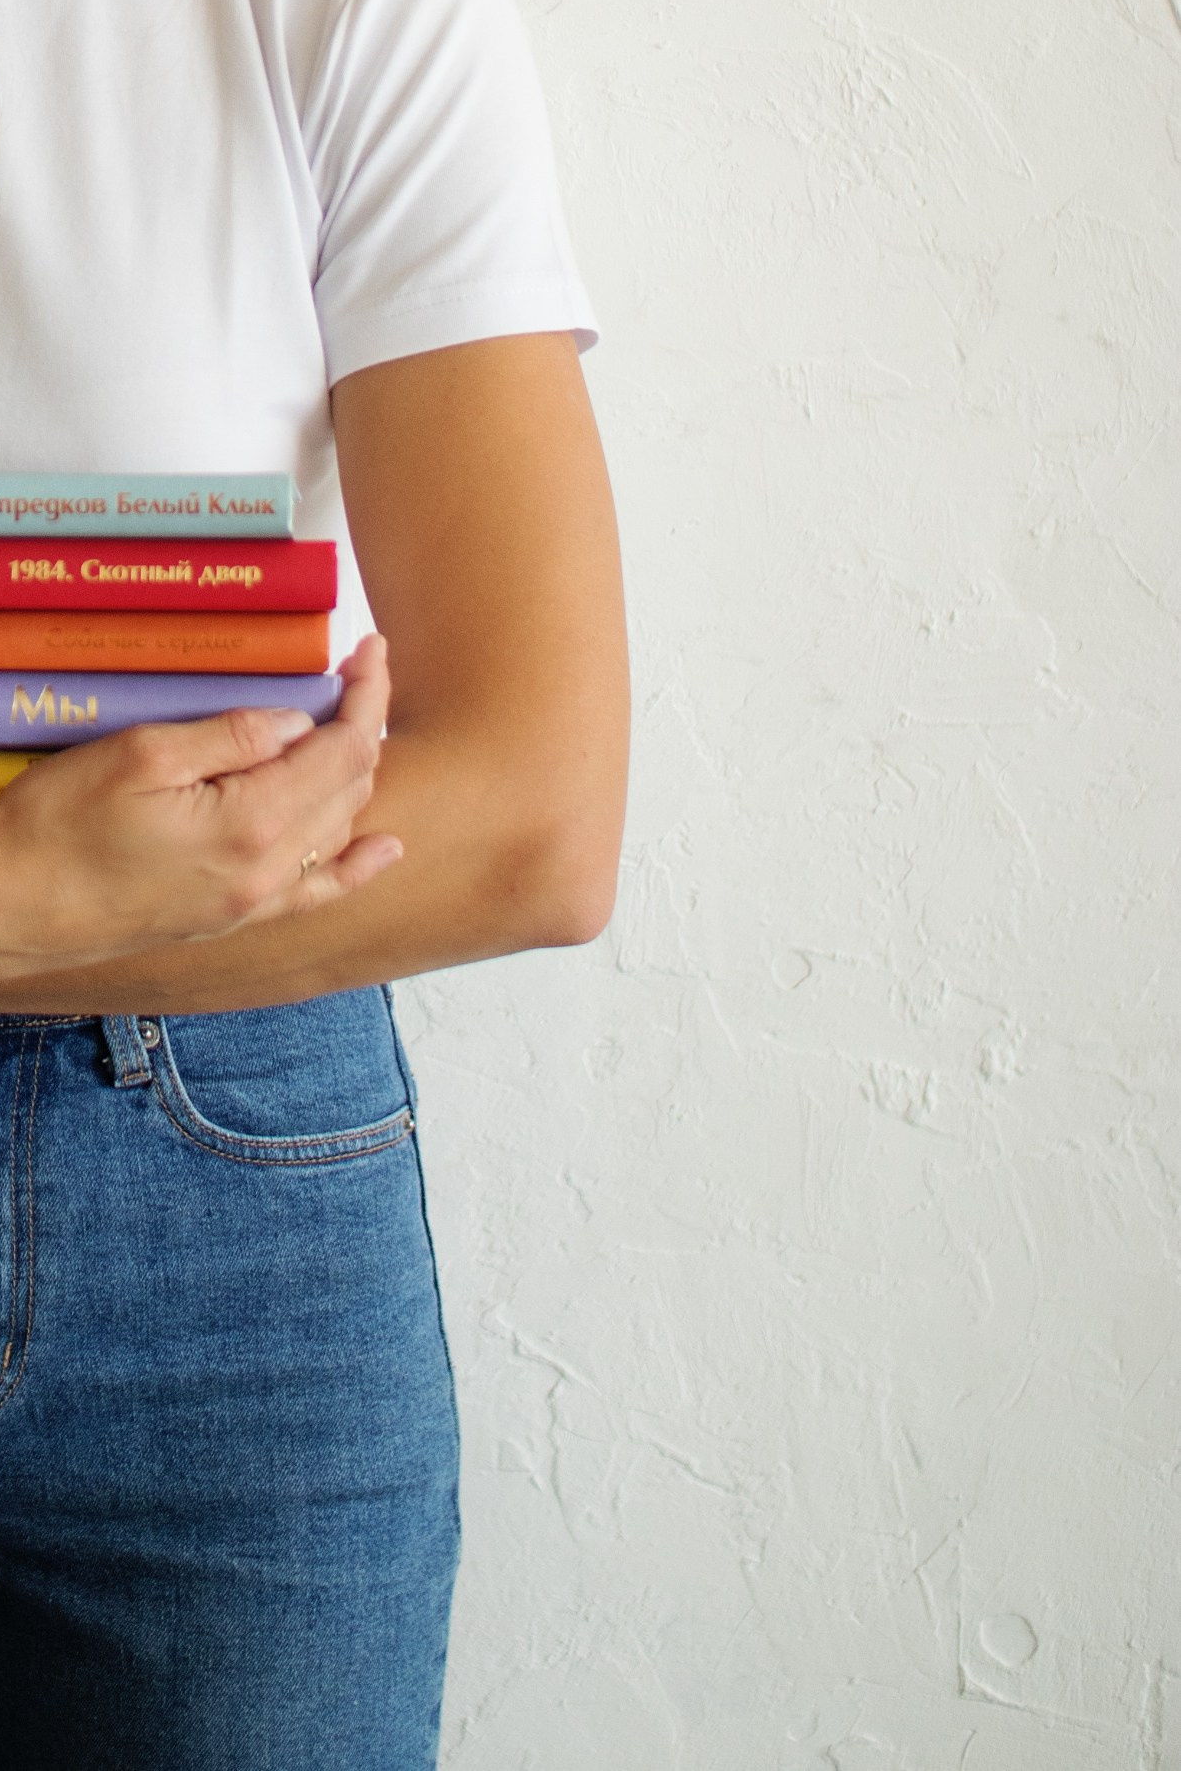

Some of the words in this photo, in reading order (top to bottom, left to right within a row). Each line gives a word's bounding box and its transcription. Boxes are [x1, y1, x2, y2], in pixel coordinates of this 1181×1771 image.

[117, 490, 200, 515] Белый
[208, 491, 275, 515] Клык
[9, 559, 74, 582] 1984.
[80, 559, 192, 582] Скотный
[198, 562, 262, 588] двор
[10, 683, 97, 725] Мы
